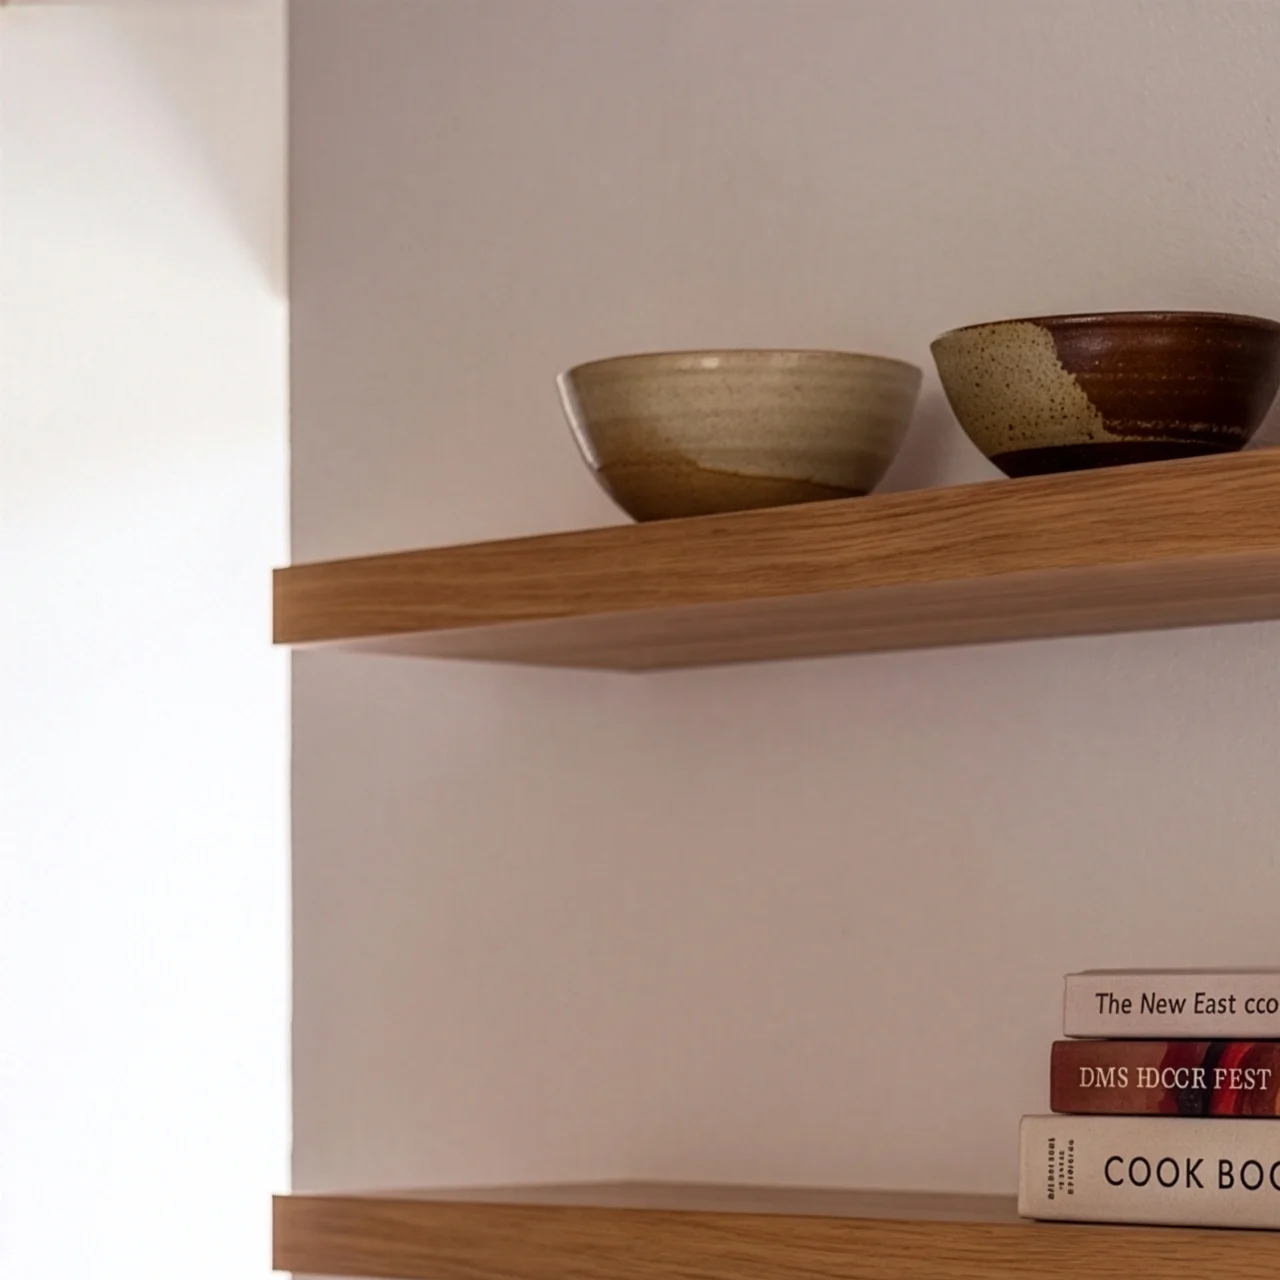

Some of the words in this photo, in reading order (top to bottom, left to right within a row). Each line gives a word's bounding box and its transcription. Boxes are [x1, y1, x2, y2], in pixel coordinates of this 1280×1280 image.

[1095, 992, 1132, 1014] The
[1140, 992, 1186, 1014] New
[1194, 992, 1236, 1014] East
[1079, 1066, 1128, 1088] DMS
[1213, 1067, 1272, 1090] FEST
[1104, 1155, 1204, 1189] COOK
